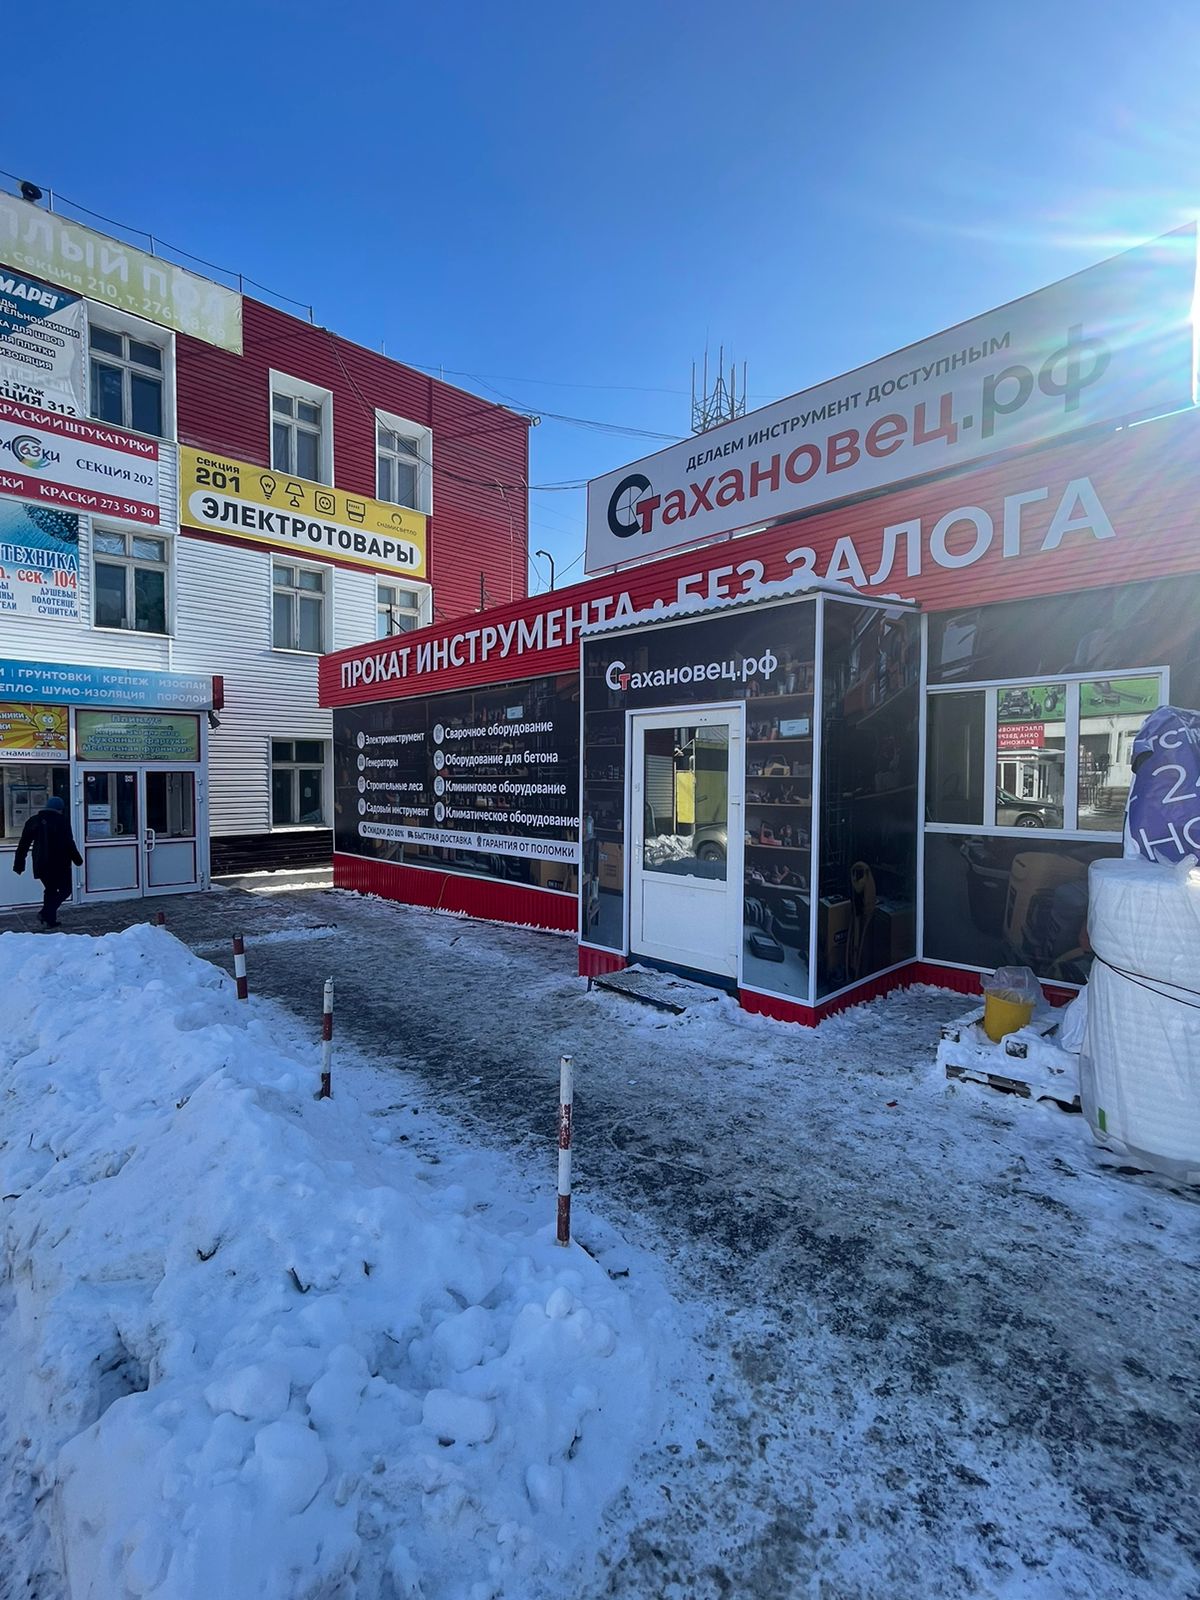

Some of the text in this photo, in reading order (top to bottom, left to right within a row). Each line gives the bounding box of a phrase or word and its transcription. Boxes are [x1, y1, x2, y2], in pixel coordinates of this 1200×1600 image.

[0, 276, 58, 309] MAPEI
[12, 324, 33, 336] ДЛЯ
[35, 332, 64, 346] ШВОВ
[46, 321, 79, 338] ХИМИИ
[0, 334, 55, 358] ЛЯ ПЛИТКИ
[13, 382, 45, 397] ЭТАЖ
[48, 400, 76, 417] 312
[686, 331, 1011, 473] ДЕЛАЕМ ИНСТРУМЕНТ ДОСТУПНЫМ
[65, 421, 154, 454] ШТУКАТУРКИ
[607, 323, 1112, 538] Стахановец.рф
[76, 458, 131, 480] СЕКЦИЯ
[134, 472, 153, 486] 202
[196, 456, 240, 475] секция
[196, 467, 240, 493] 201
[40, 485, 97, 506] КРАСКИ
[100, 499, 120, 512] 273
[123, 503, 137, 515] 50
[140, 508, 154, 519] 50
[202, 497, 414, 565] ЭЛЕКТРОТОВАРЫ
[1, 544, 77, 571] ТЕХНИКА
[17, 569, 48, 585] сек.
[54, 570, 77, 589] 104
[341, 476, 1116, 688] ПРОКАТ ИНСТРУМЕНТА БЕЗ ЗАЛОГА
[18, 669, 92, 682] ГРУНТОВКИ
[103, 675, 149, 686] КРЕПЕЖ
[159, 679, 206, 690] ИЗОСПАН
[605, 649, 778, 690] Стахановец.рф
[41, 686, 145, 700] ШУМО-ИЗОЛЯЦИЯ
[157, 693, 207, 703] ПОРОЛОН
[365, 732, 424, 746] Электроинструмент
[444, 720, 553, 740] Сварочное оборудование
[1, 750, 62, 758] снамисветло
[365, 757, 399, 768] Генераторы
[445, 750, 558, 767] Оборудование для бетона
[408, 782, 424, 791] леса
[445, 780, 567, 796] Клининговое оборудование
[366, 803, 429, 818] Садовый инструмент
[445, 807, 580, 828] Климатическое оборудование
[414, 831, 440, 842] БЫСТРАЯ
[440, 833, 472, 846] ДОСТАВКА
[482, 838, 519, 851] ГАРАНТИЯ
[519, 841, 530, 852] ОТ
[531, 843, 575, 858] ПОЛОМКИ
